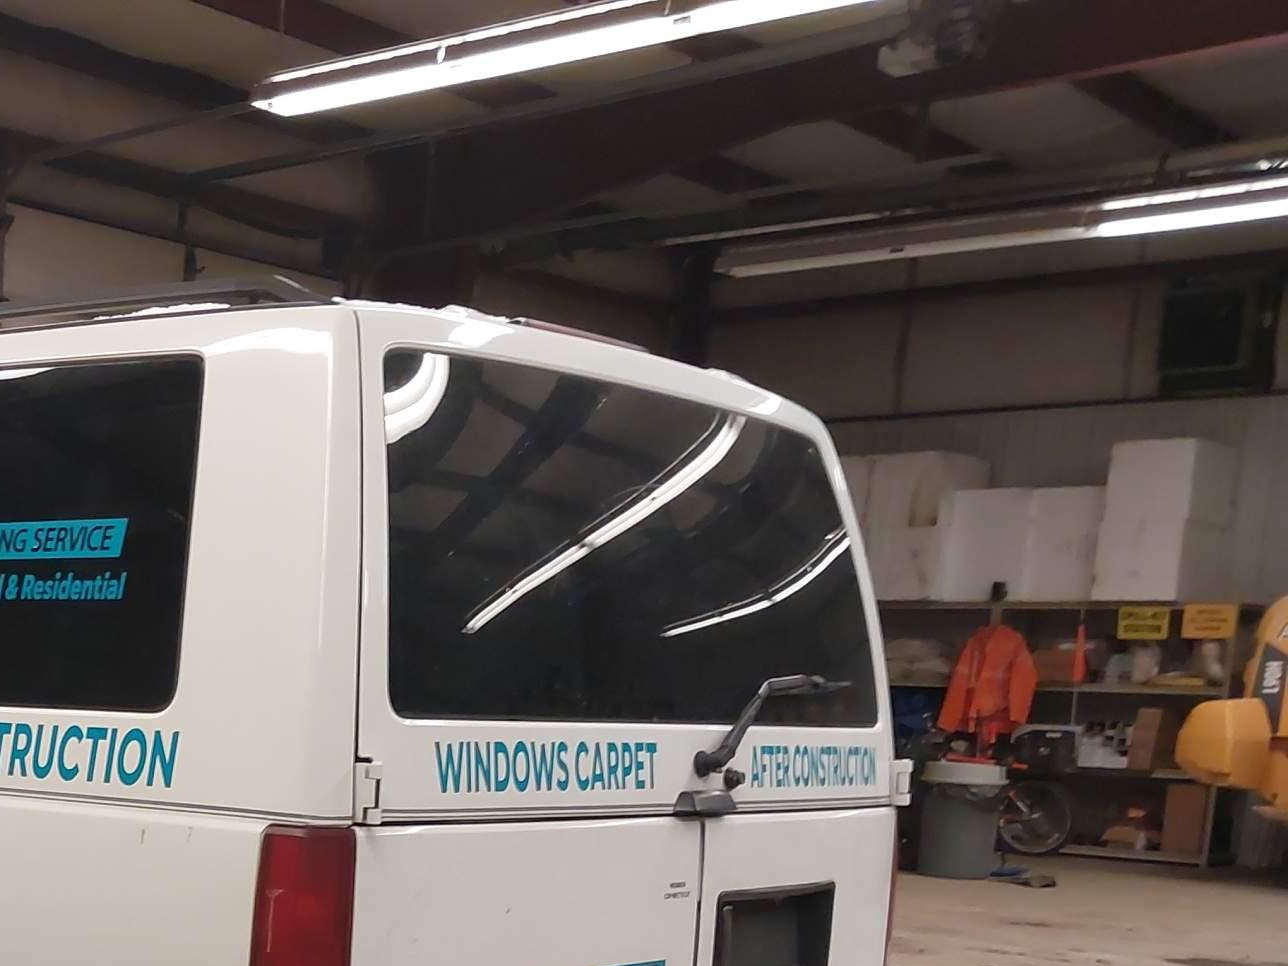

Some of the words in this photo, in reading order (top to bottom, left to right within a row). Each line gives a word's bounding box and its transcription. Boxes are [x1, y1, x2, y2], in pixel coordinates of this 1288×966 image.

[31, 524, 115, 553] SERVICE
[5, 574, 19, 600] &
[20, 571, 127, 600] Residential
[434, 740, 569, 793] WINDOWS
[575, 740, 657, 791] CARPET
[750, 745, 791, 787] AFTER
[792, 744, 877, 788] CONSTRUCTION
